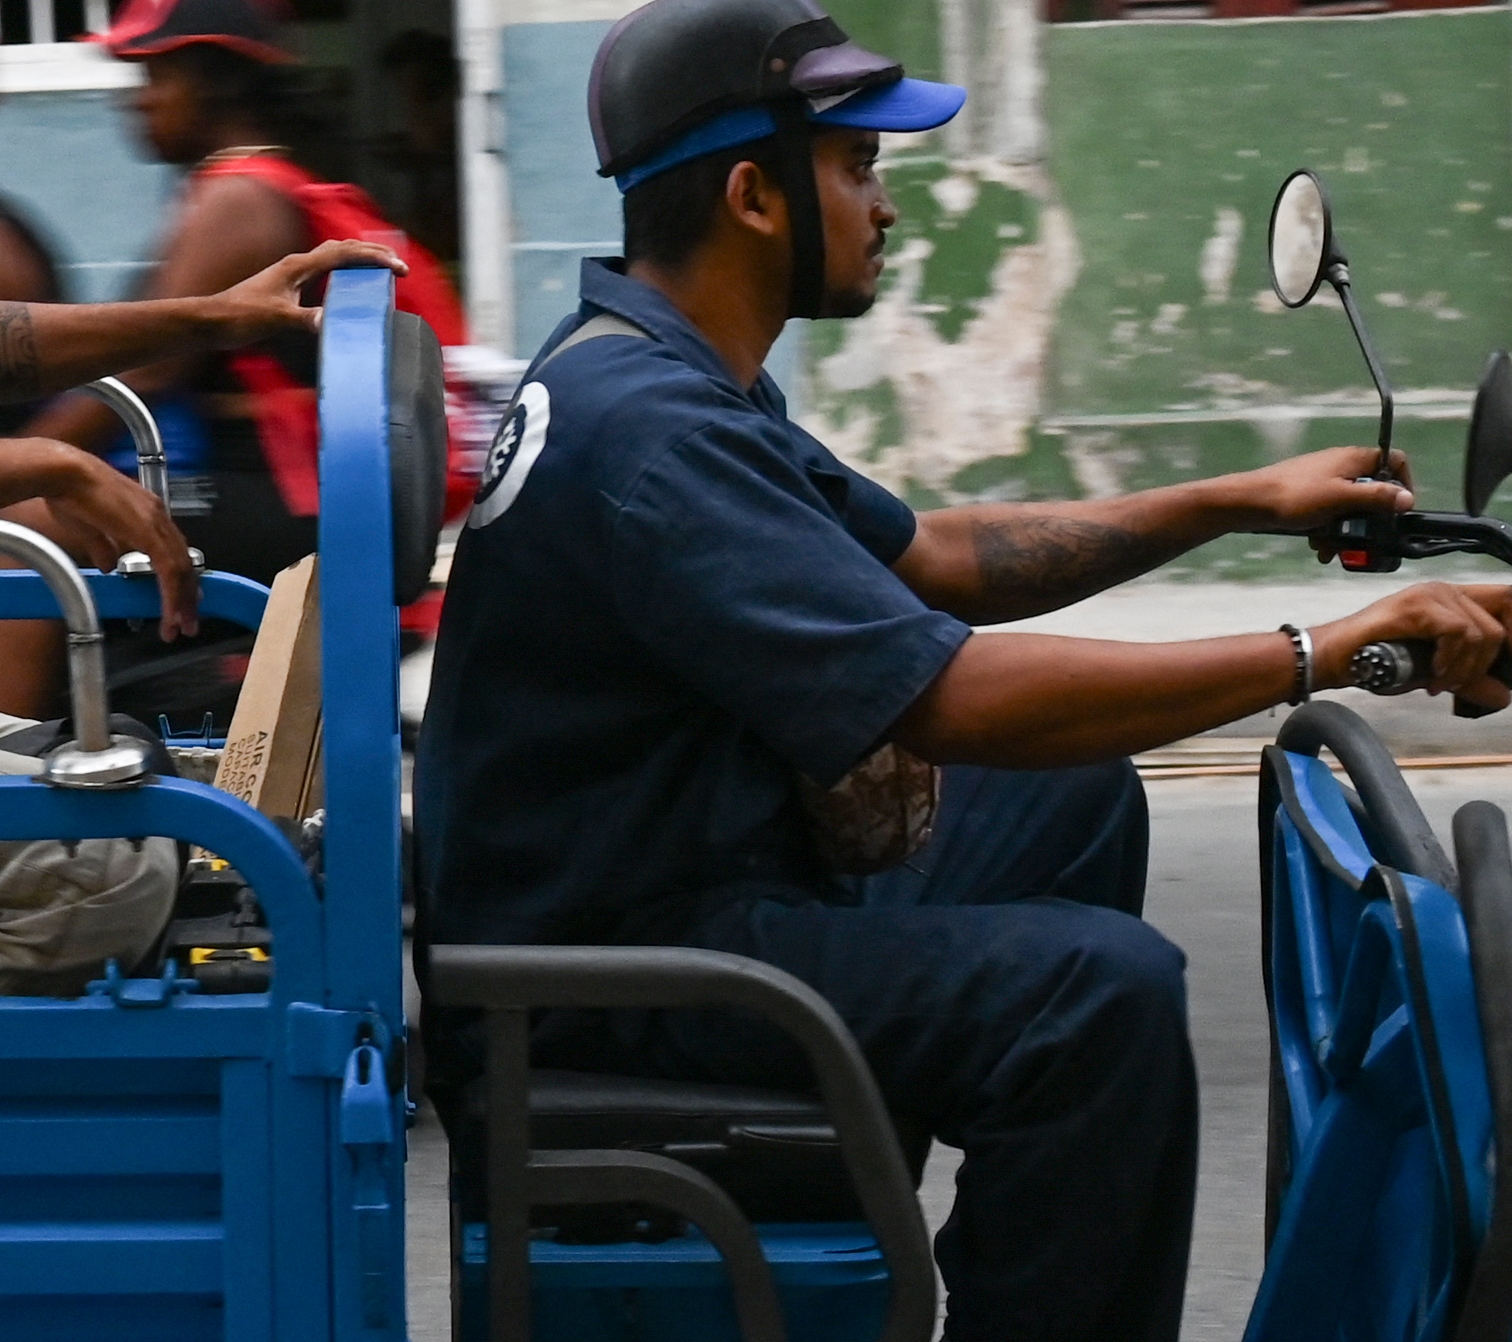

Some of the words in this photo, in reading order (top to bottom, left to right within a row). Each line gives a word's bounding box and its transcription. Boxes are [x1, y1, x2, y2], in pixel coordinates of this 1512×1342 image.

[220, 742, 237, 787] MODE
[249, 730, 268, 769] AIR
[242, 773, 256, 802] CO
